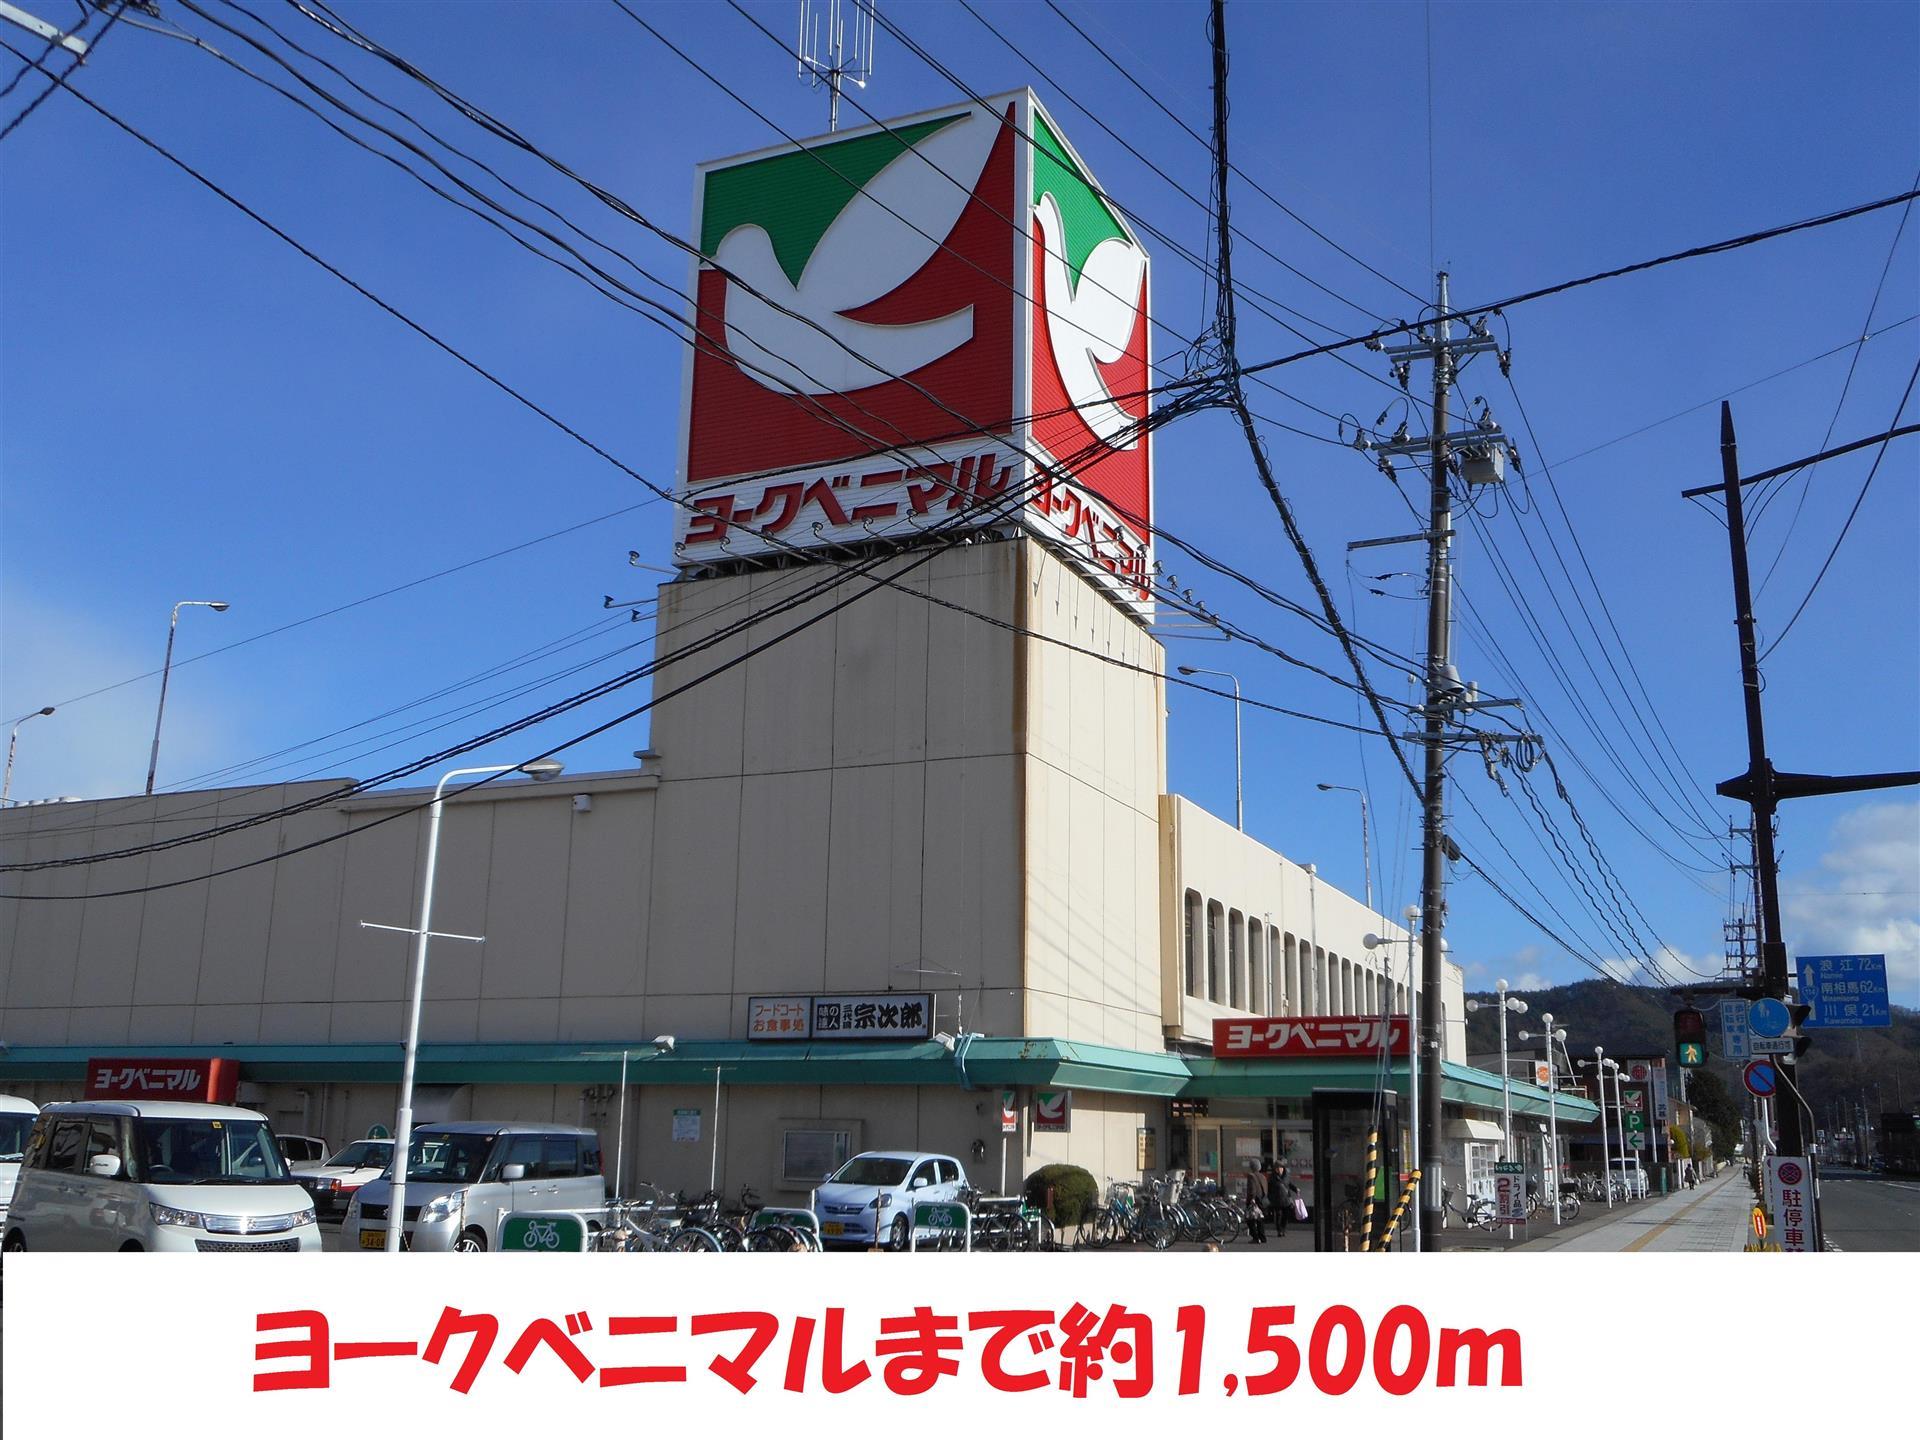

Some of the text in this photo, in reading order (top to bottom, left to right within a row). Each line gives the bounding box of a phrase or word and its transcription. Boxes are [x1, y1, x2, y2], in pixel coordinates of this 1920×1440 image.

[685, 453, 1012, 545] ヨークベニマル
[1821, 981, 1859, 994] 南相馬
[754, 1003, 805, 1017] フードコート
[753, 1018, 805, 1033] お食事処
[1226, 1022, 1400, 1049] ヨークベニマル
[94, 1068, 201, 1091] ヨークベニマル
[1629, 1115, 1640, 1129] P
[1782, 1189, 1805, 1252] 駐停車
